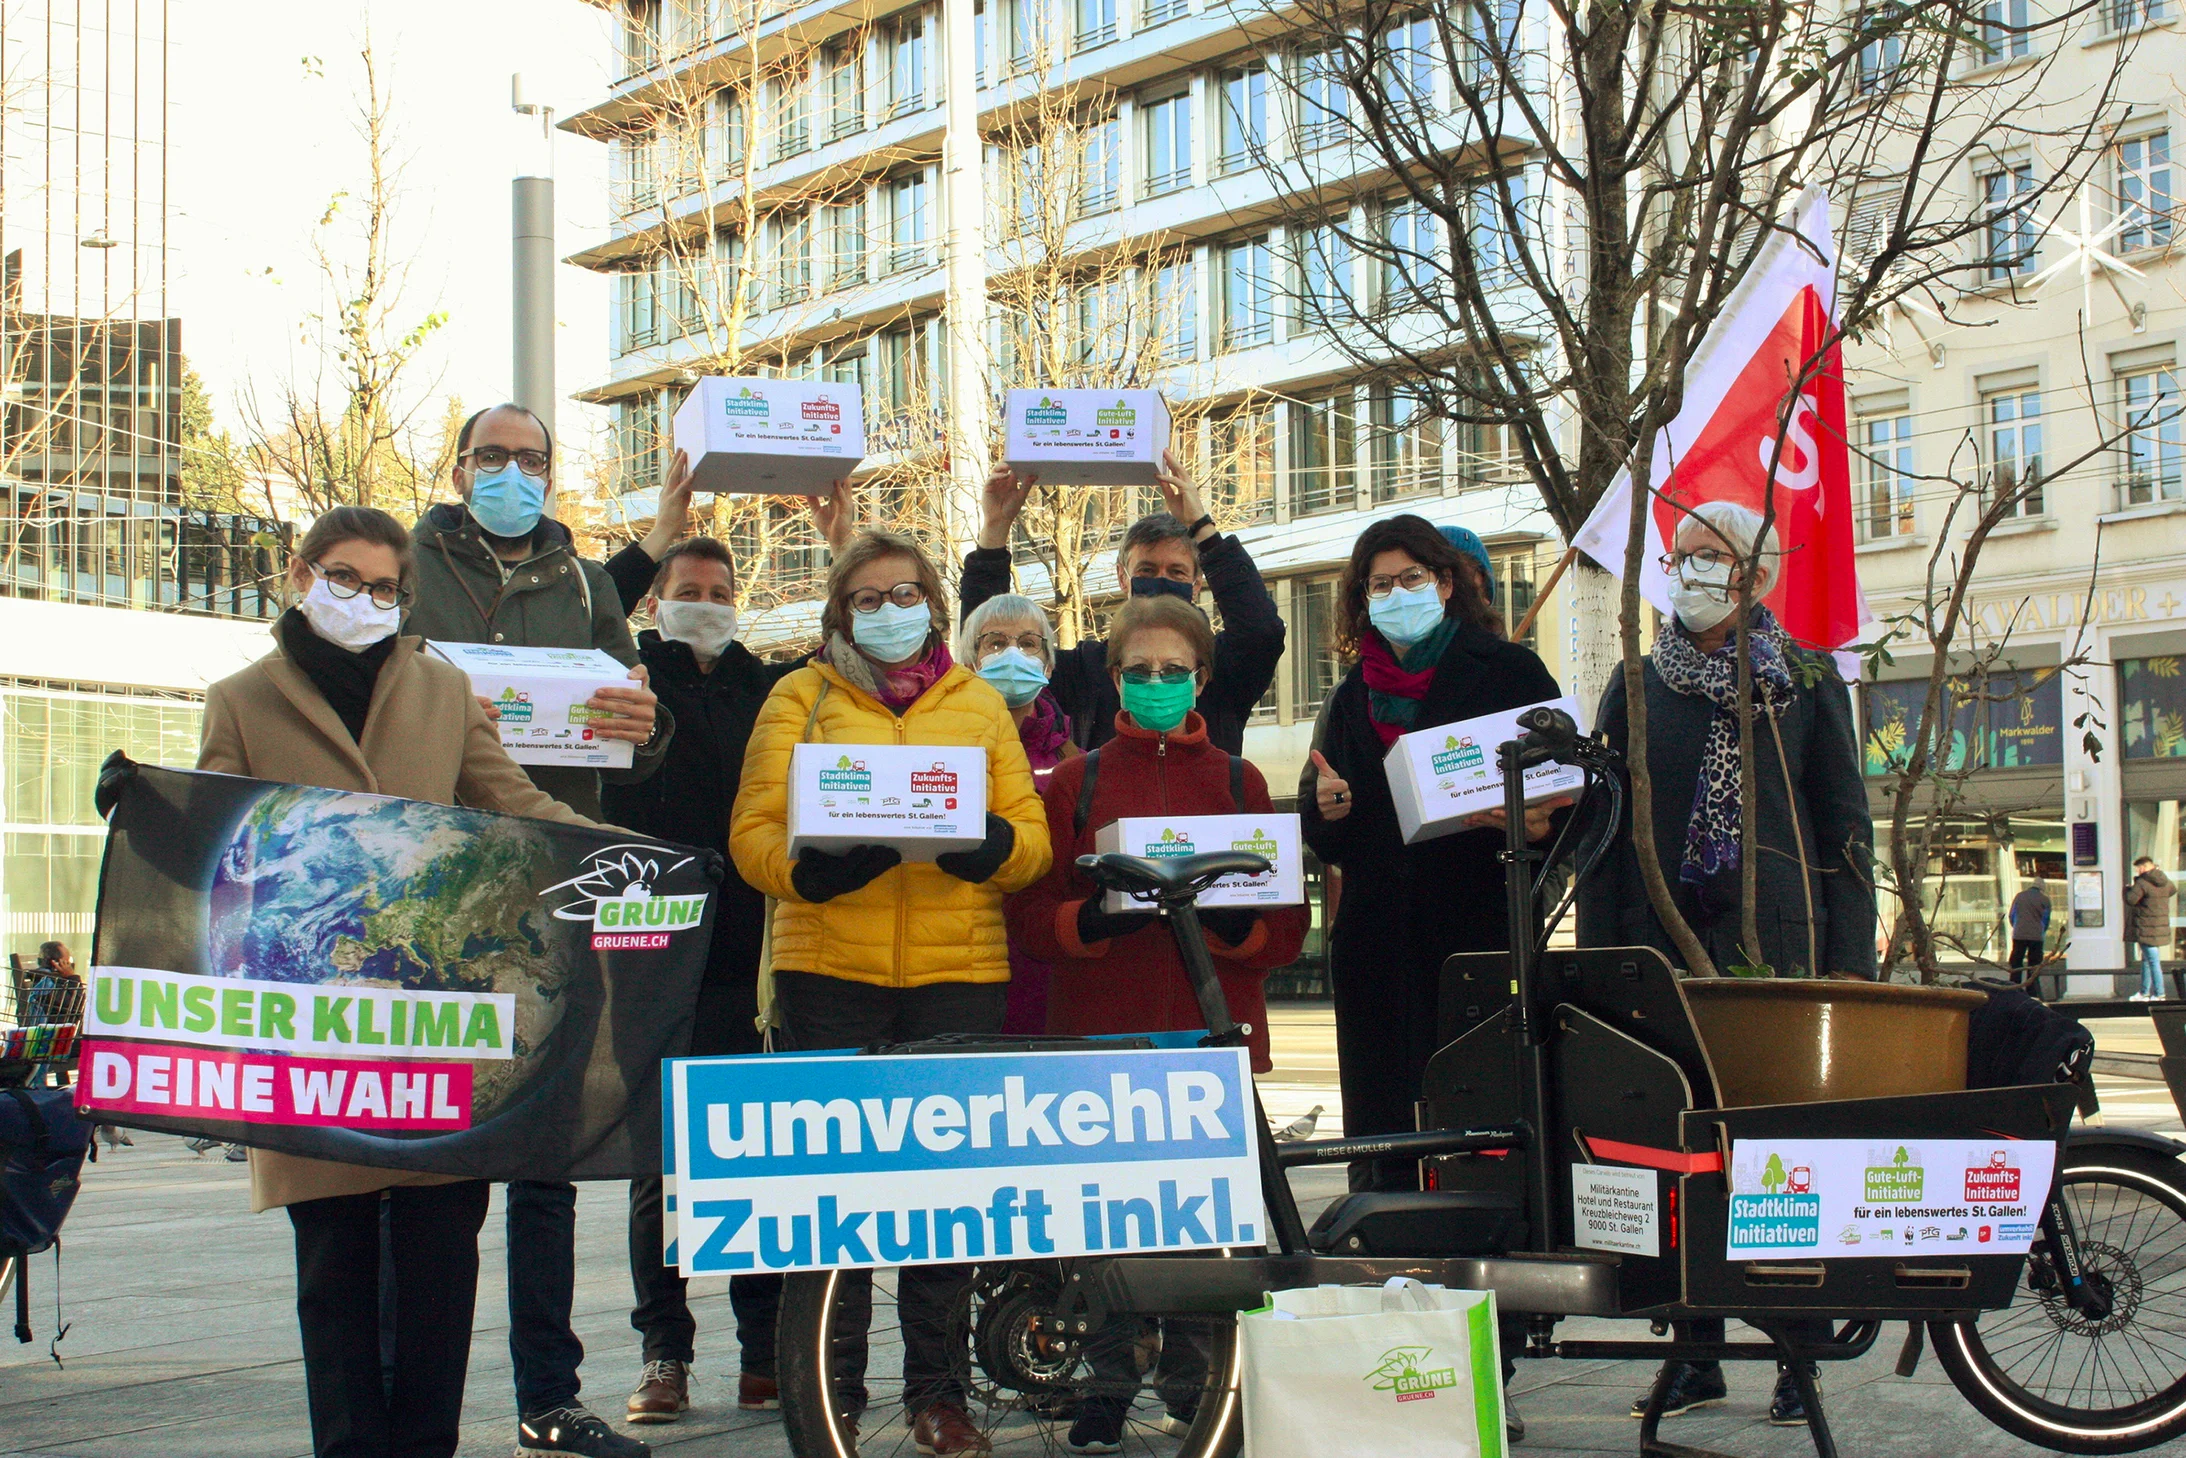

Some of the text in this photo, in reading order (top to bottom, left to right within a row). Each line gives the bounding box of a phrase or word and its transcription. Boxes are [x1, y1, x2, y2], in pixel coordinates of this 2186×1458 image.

[726, 400, 768, 409] Stadtklima
[802, 403, 839, 413] Zukunfts-
[727, 408, 769, 416] Initiativen
[803, 411, 839, 420] Initiative
[1098, 410, 1134, 418] Gute-Luft-
[1098, 417, 1134, 425] Initiative
[2000, 725, 2055, 737] Markwalder
[1432, 747, 1480, 764] Stadtklima
[1436, 757, 1483, 774] Initiativen
[821, 772, 871, 781] Stadtklima
[912, 773, 956, 783] Zukunfts-
[1536, 767, 1561, 778] Gallen!
[821, 781, 870, 791] Initiativen
[912, 783, 956, 793] Initiative
[829, 811, 840, 819] für
[855, 811, 906, 820] lebenswertes
[1147, 844, 1194, 853] Stadtklima
[1233, 842, 1276, 851] Gute-Luft-
[600, 896, 705, 926] GRÜNE
[594, 935, 668, 948] GRUENE.CH
[96, 978, 501, 1049] UNSER KLIMA
[92, 1054, 461, 1120] DEINE WAHL
[707, 1070, 1230, 1159] umverkehR
[1867, 1171, 1921, 1183] Gute-Luft-
[1967, 1171, 2018, 1183] Zukunfts-
[1590, 1184, 1639, 1197] Militärkantine
[1867, 1187, 1921, 1199] Initiative
[1966, 1187, 2018, 1199] Initiative
[1577, 1195, 1654, 1211] Hotel und Restaurant
[1734, 1198, 1817, 1218] Stadtklima
[1582, 1207, 1650, 1225] Kreuzbleicheweg 2
[1854, 1206, 2027, 1218] für ein lebenswertes St. Gallen!
[692, 1186, 1054, 1272] Zukunft
[1081, 1177, 1255, 1250] inkl.
[1588, 1220, 1644, 1235] 9000 St. Gallen
[1733, 1224, 1816, 1244] Initiativen
[1397, 1372, 1452, 1391] GRÜNE
[1398, 1392, 1434, 1402] GRUENE.CH
